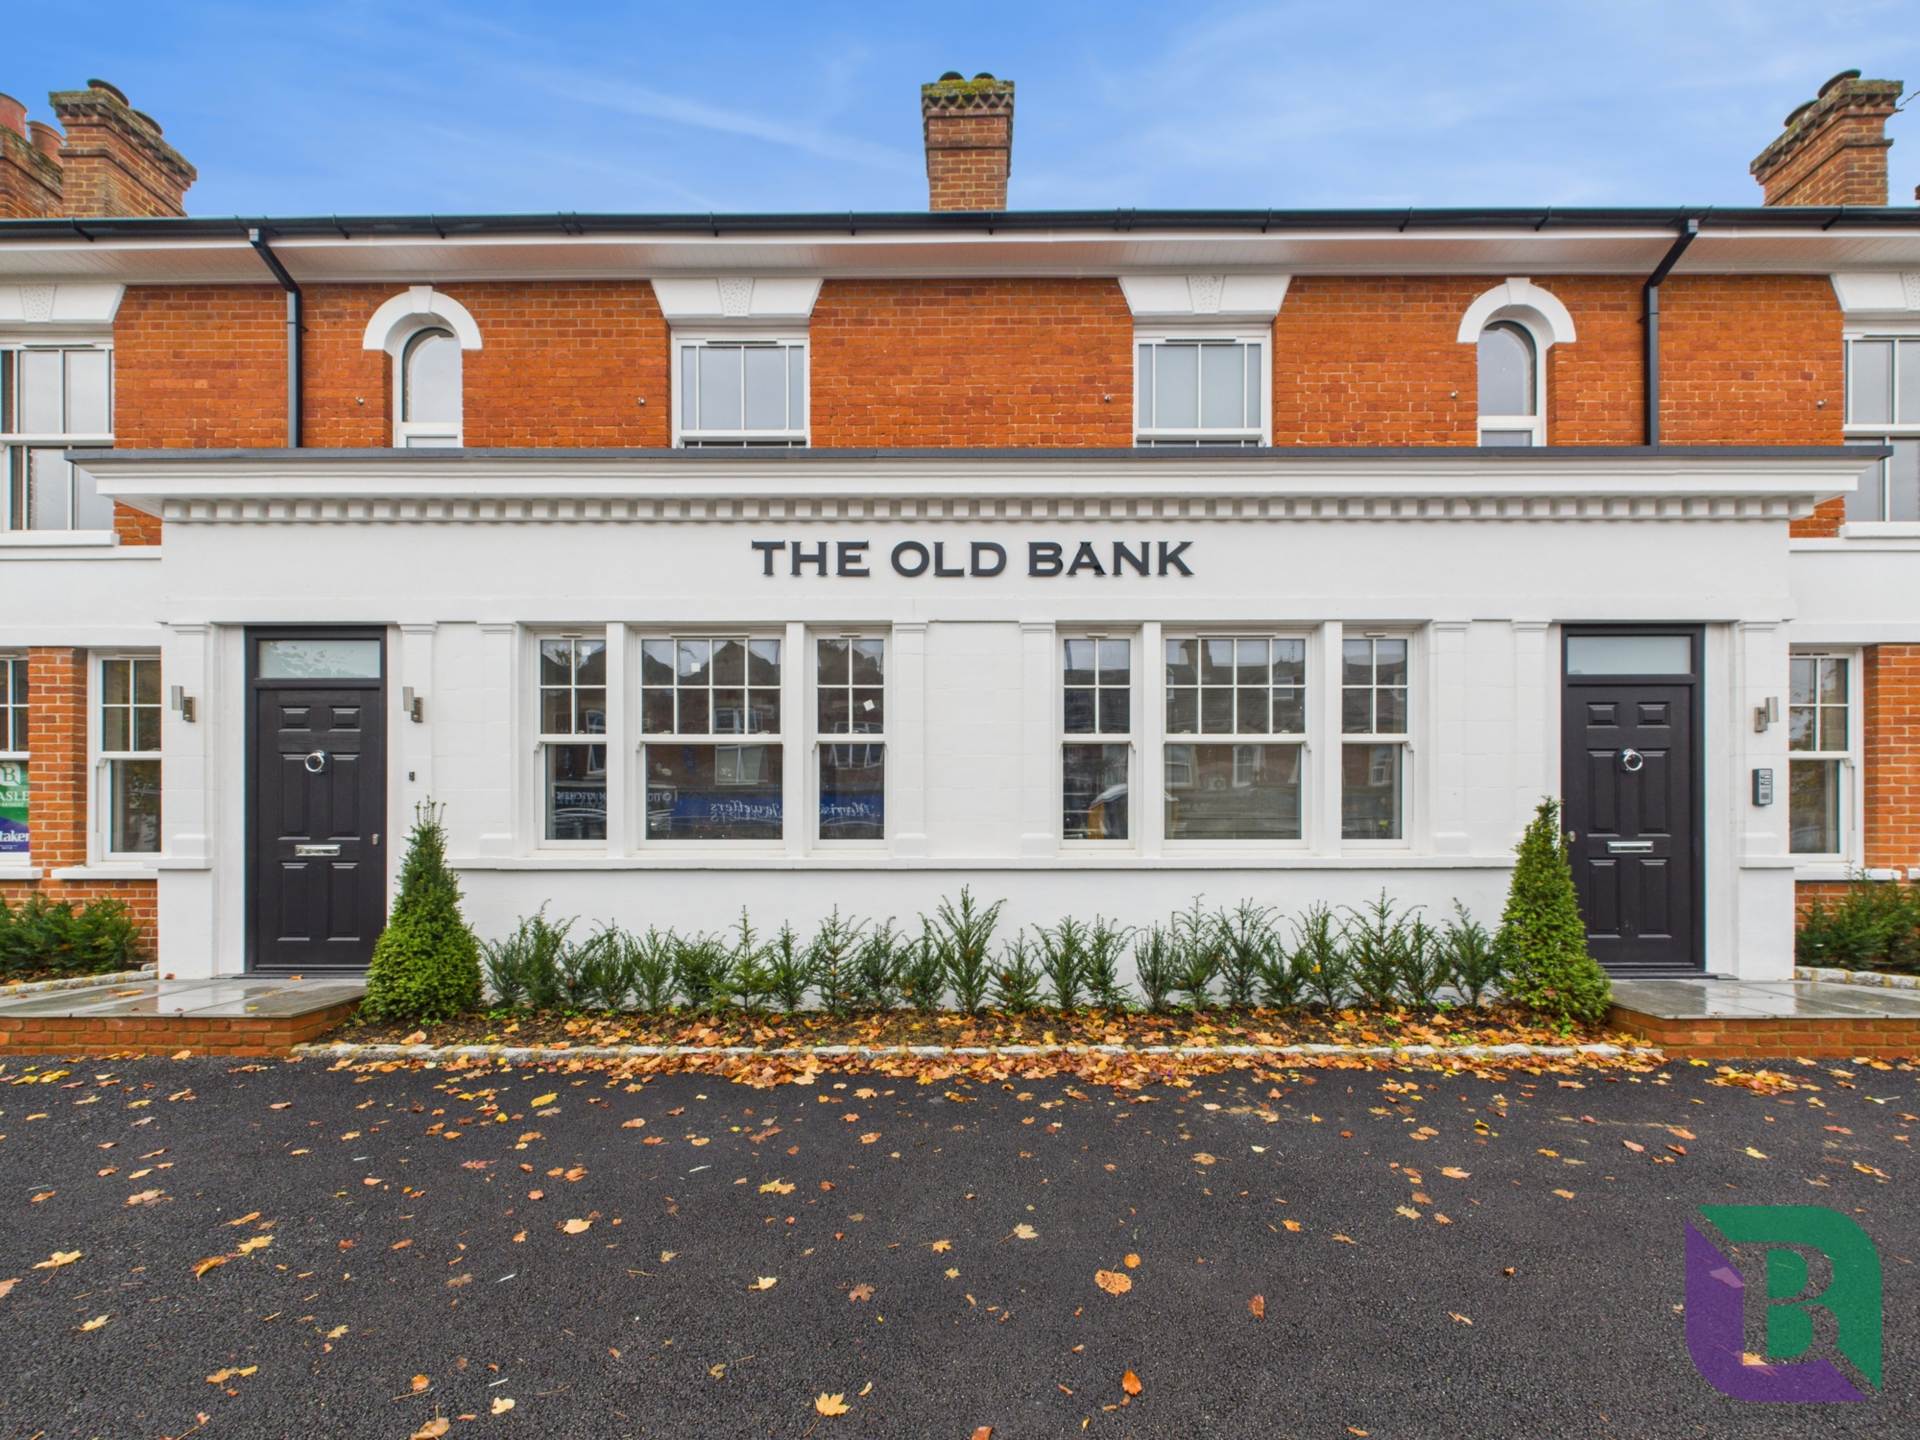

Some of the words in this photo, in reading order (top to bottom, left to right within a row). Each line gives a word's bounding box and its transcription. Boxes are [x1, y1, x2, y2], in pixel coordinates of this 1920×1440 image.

[751, 539, 870, 577] THE
[891, 540, 1008, 578] OLD
[1027, 541, 1195, 577] BANK
